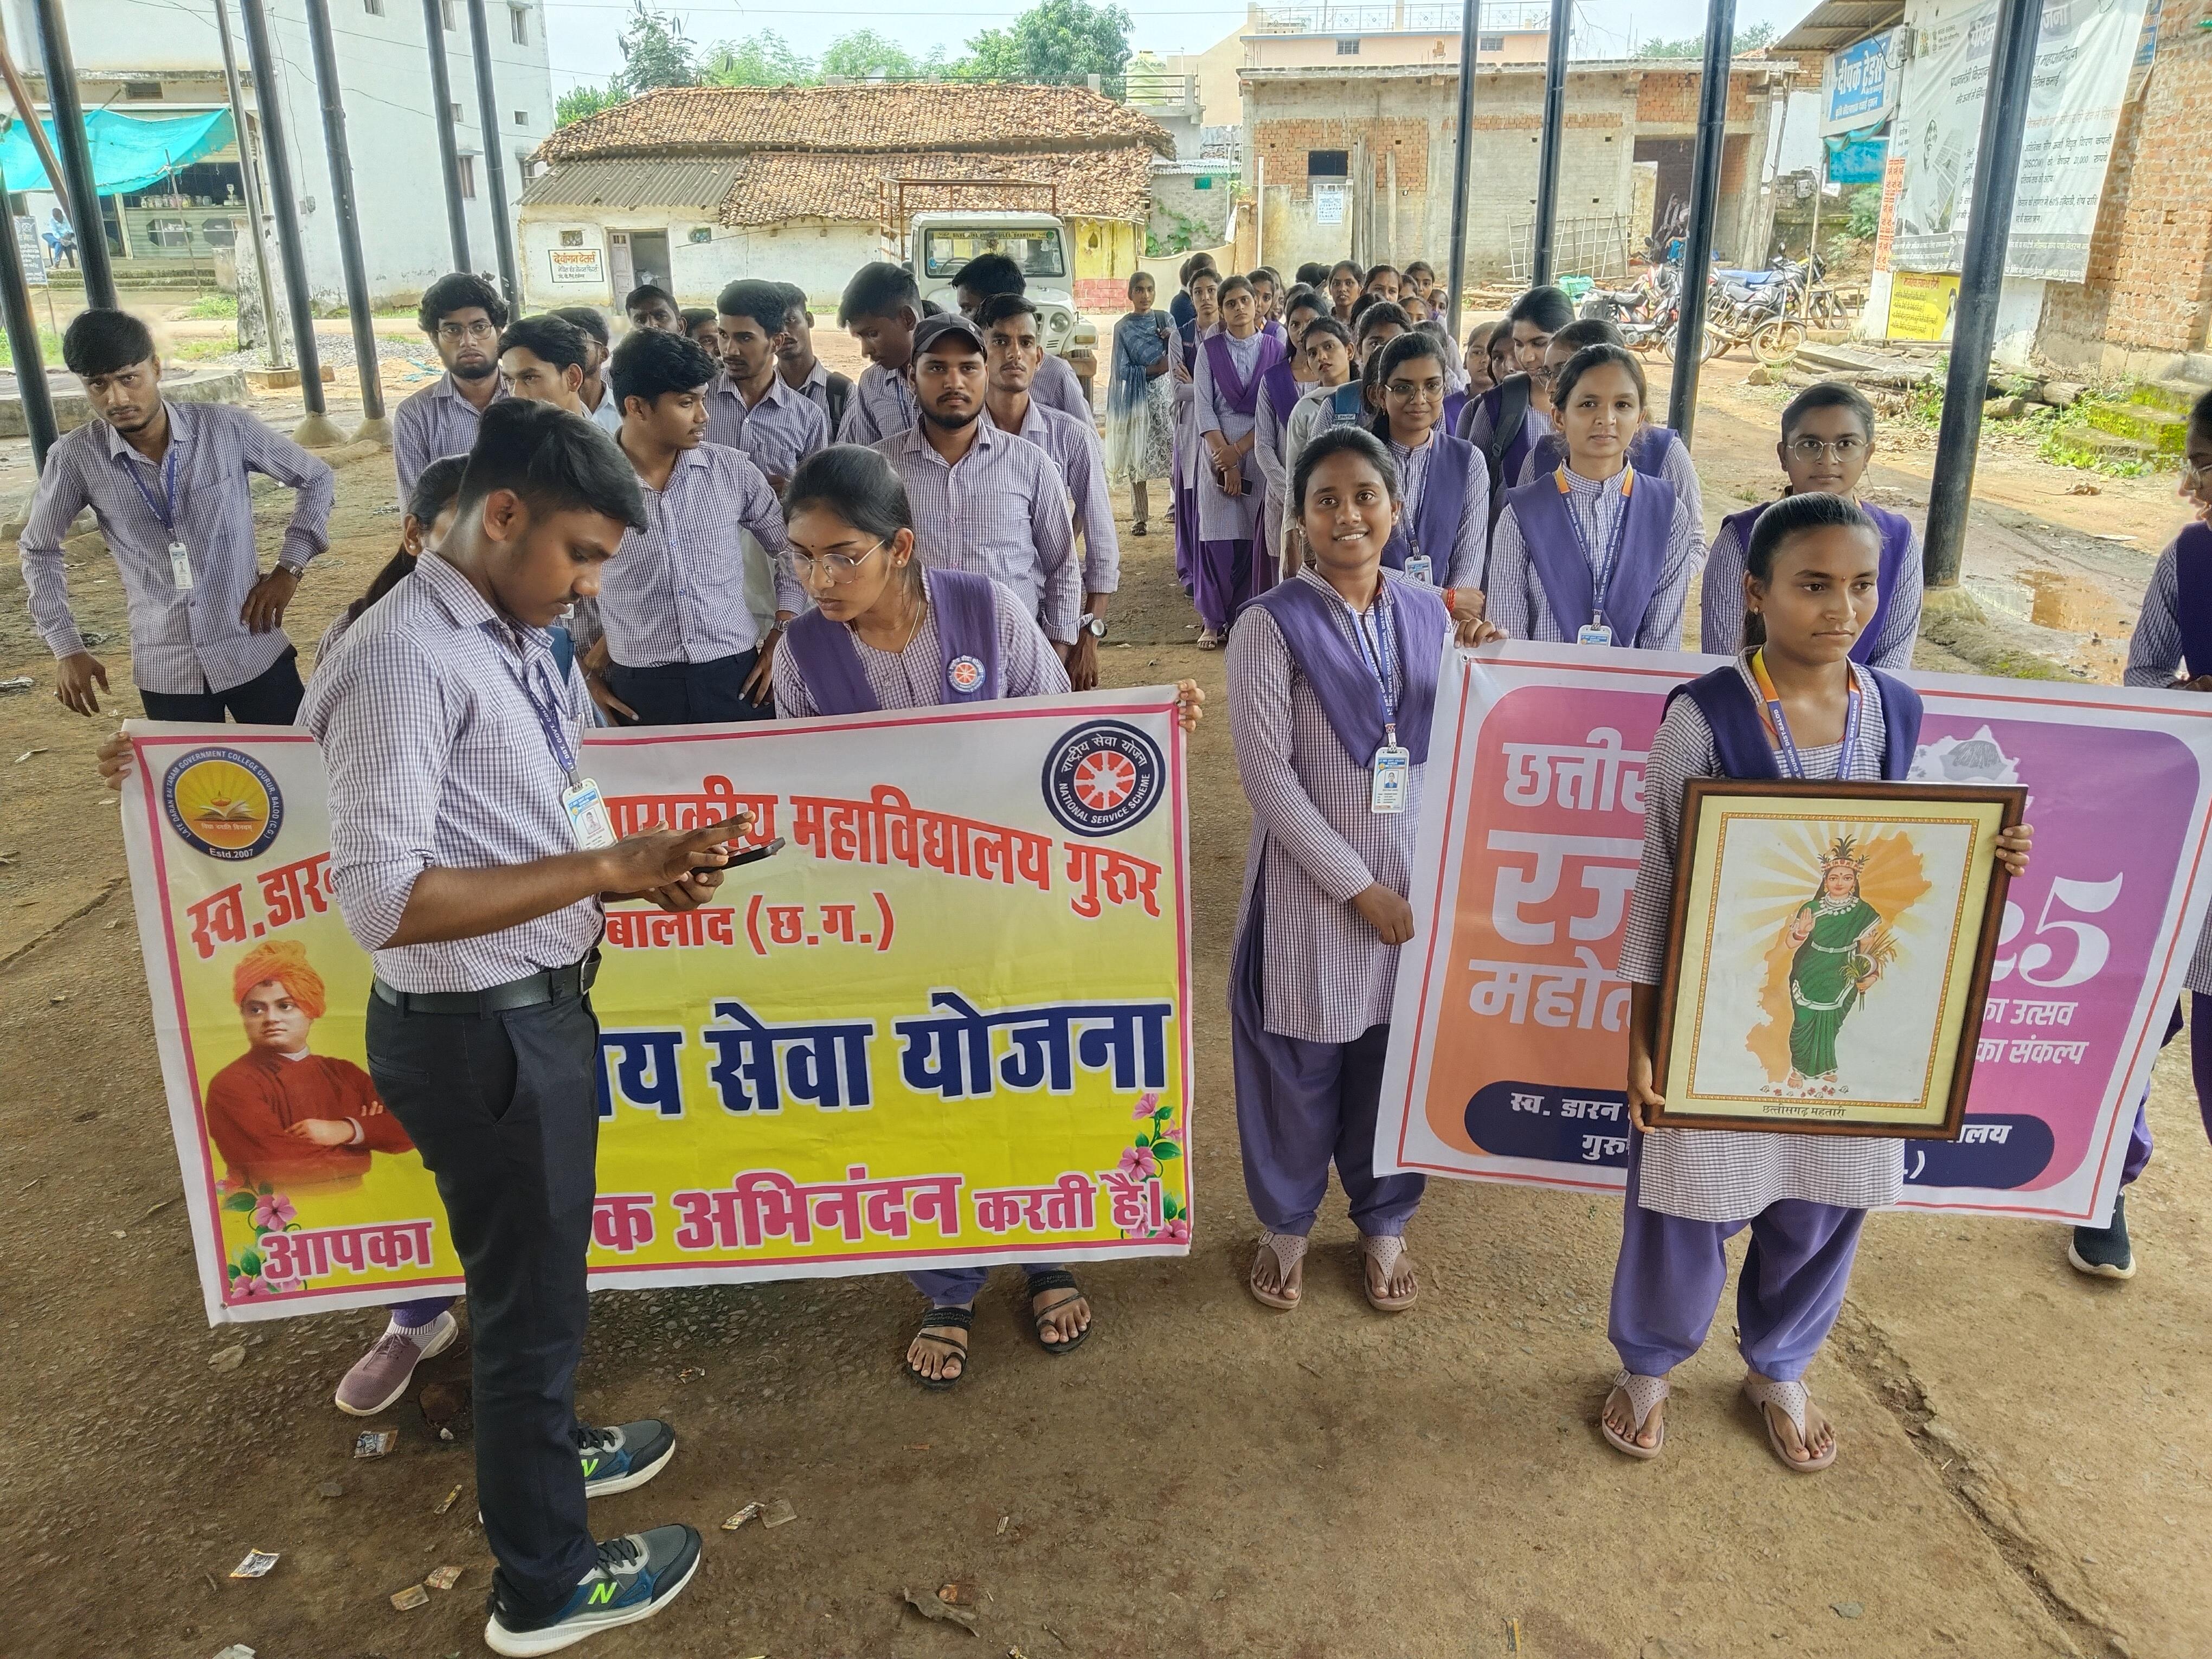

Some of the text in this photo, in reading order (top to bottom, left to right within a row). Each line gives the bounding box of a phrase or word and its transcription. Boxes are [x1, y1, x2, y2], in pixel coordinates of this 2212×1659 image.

[1838, 59, 1862, 95] दीपक
[554, 252, 578, 265] देवांगन
[178, 750, 227, 769] GOVERNMENT
[227, 752, 259, 772] COLLEGE
[1061, 733, 1148, 774] राष्ट्रीय सेवा योजना
[166, 767, 179, 787] TARAM
[169, 800, 180, 823] DARAN
[271, 796, 280, 820] BALOD
[1059, 773, 1150, 824] NATIONAL SERVICE SCHEME
[176, 824, 192, 839] LATE
[789, 784, 1053, 891] महाविद्यालय
[747, 892, 895, 955] (छ.ग.)
[2010, 999, 2079, 1026] उत्सव
[704, 1002, 873, 1111] सेवा
[895, 992, 1172, 1097] योजना
[1975, 1034, 2089, 1065] का संकल्प
[1510, 1092, 1623, 1122] स्व. डारन
[1811, 1106, 1847, 1119] महतारी
[261, 1221, 432, 1279] आपका
[673, 1167, 963, 1248] अभिनंदन
[974, 1174, 1097, 1231] करती
[587, 1581, 618, 1605] N
